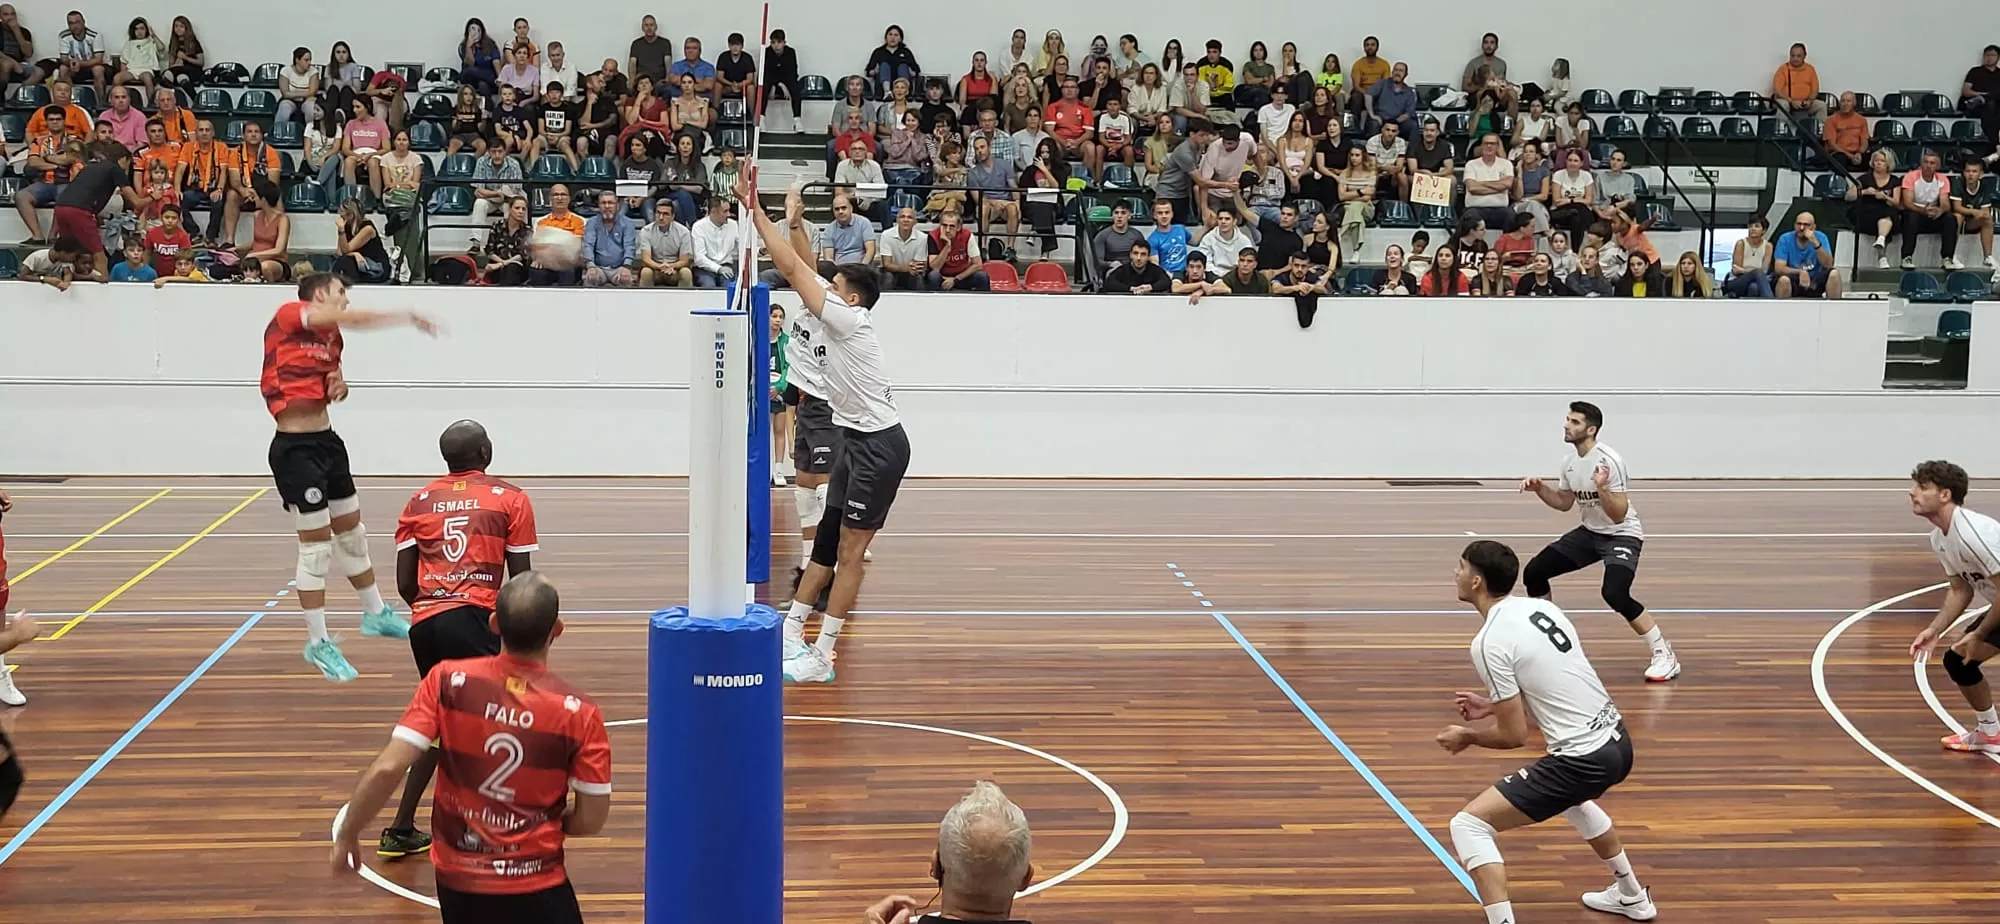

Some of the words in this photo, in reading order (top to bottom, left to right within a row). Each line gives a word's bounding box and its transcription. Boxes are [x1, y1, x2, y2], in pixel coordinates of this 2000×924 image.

[714, 342, 725, 389] MONDO
[433, 499, 481, 513] ISMAEL
[442, 515, 470, 563] 5
[1529, 611, 1573, 654] 8
[707, 673, 763, 688] MONDO
[484, 702, 534, 729] FALO
[478, 732, 524, 802] 2
